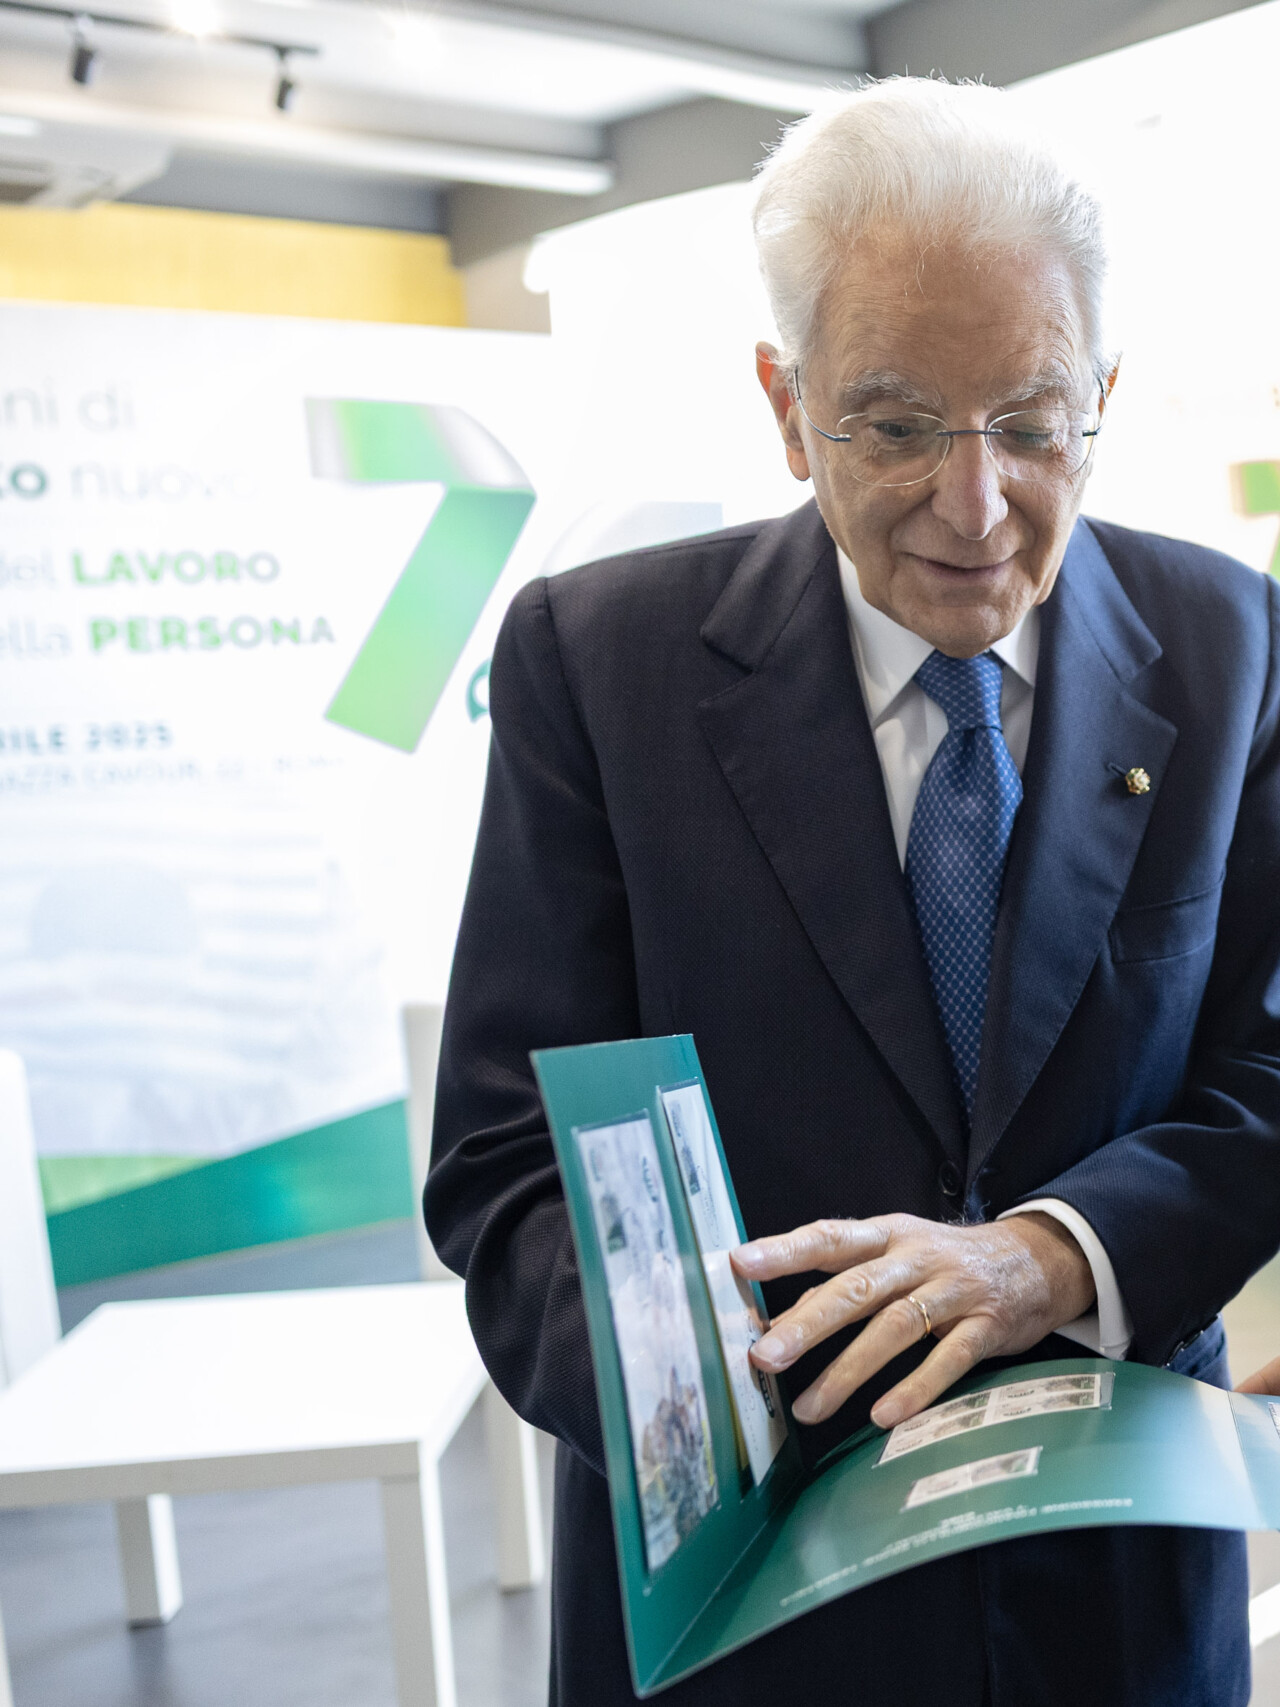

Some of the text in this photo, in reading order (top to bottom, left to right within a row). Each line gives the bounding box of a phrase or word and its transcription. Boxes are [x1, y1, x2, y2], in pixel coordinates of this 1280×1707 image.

[77, 379, 136, 433] di
[72, 549, 281, 587] LAVORO
[90, 615, 336, 655] PERSONA
[0, 724, 67, 756] ILE
